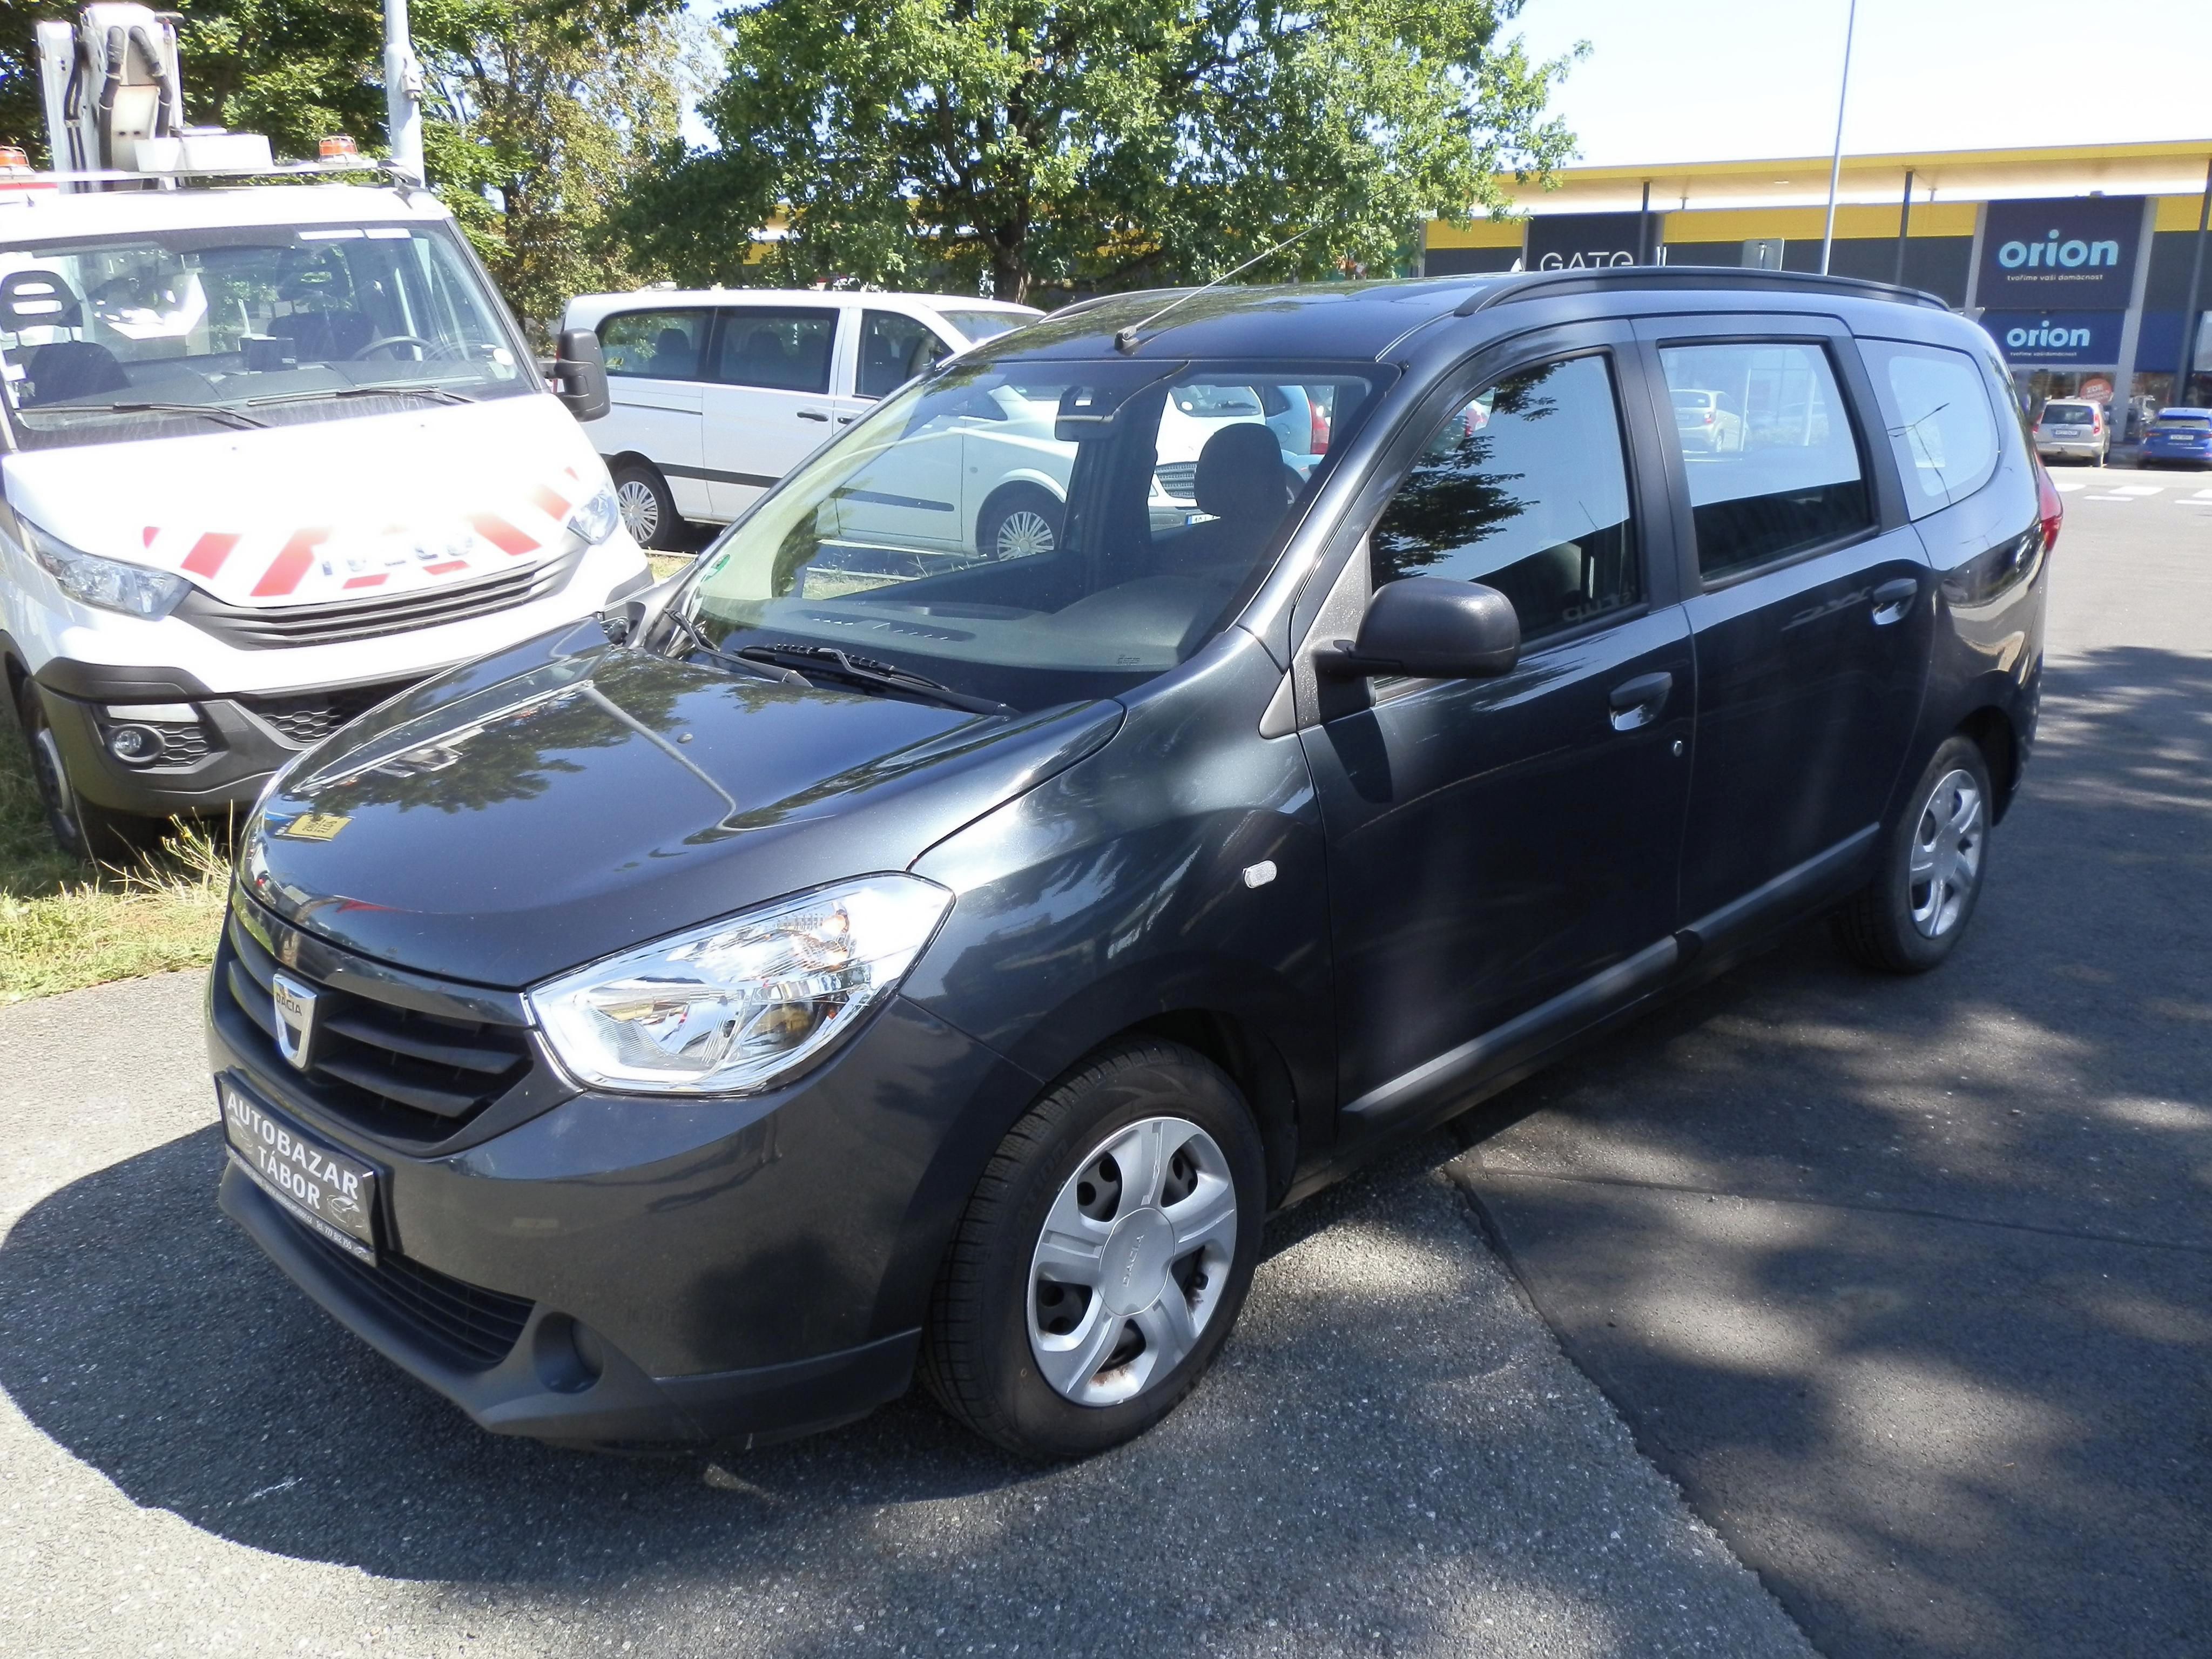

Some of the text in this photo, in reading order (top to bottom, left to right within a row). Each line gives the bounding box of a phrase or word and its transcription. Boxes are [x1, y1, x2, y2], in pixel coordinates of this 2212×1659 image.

[1999, 229, 2119, 268] orion
[2007, 320, 2090, 347] orion
[276, 993, 302, 1016] DACIA
[227, 1091, 358, 1200] AUTOBAZAR
[258, 1145, 320, 1210] TÁBOR
[1123, 1235, 1145, 1287] DACIA
